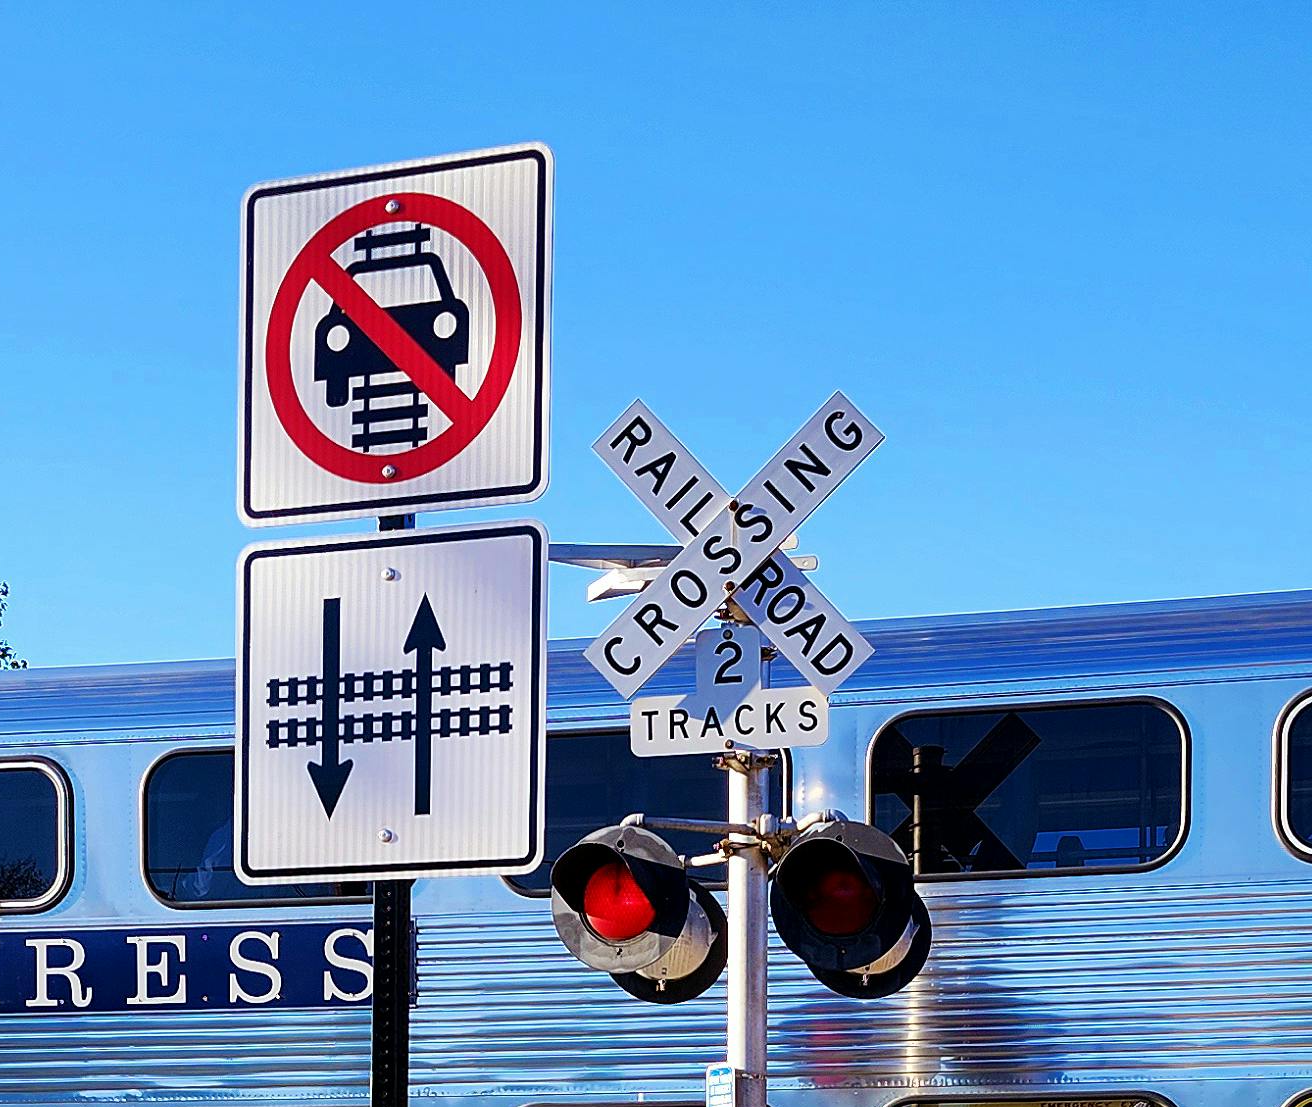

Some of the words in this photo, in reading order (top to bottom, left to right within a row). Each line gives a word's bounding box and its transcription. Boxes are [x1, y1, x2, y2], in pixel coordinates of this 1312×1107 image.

[603, 409, 865, 677] CROSSING
[713, 640, 744, 686] 2
[641, 699, 819, 742] TRACKS
